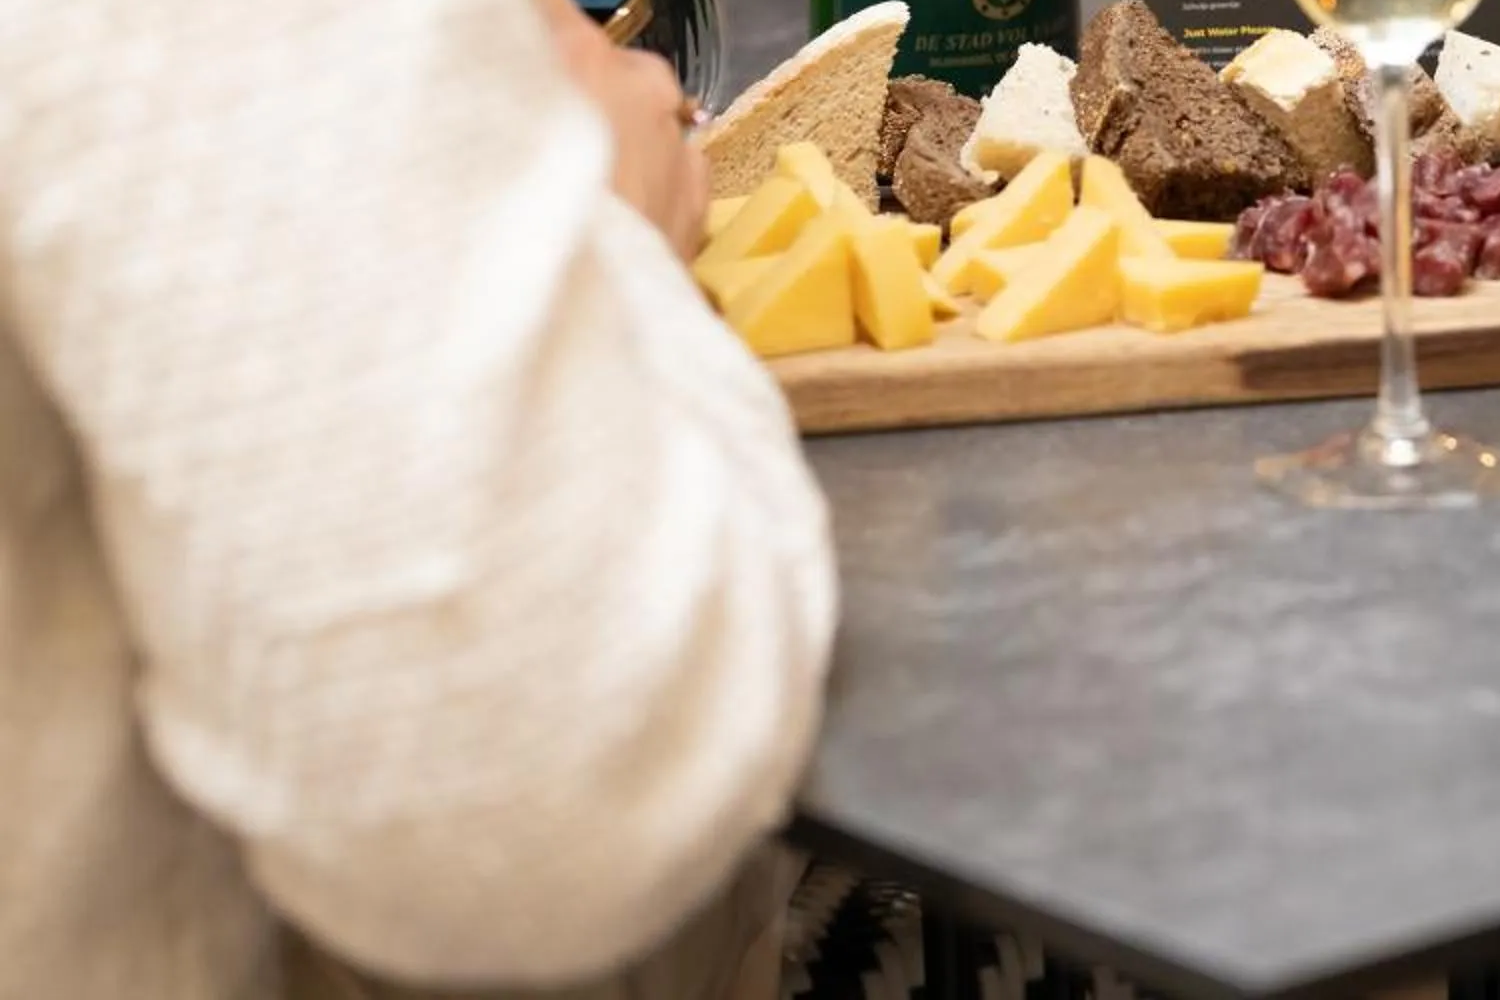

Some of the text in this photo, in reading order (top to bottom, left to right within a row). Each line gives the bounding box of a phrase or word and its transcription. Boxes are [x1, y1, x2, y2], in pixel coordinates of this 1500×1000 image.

[1183, 28, 1206, 38] Just
[1207, 27, 1239, 37] Water
[914, 33, 941, 53] DE
[944, 31, 994, 51] STAD
